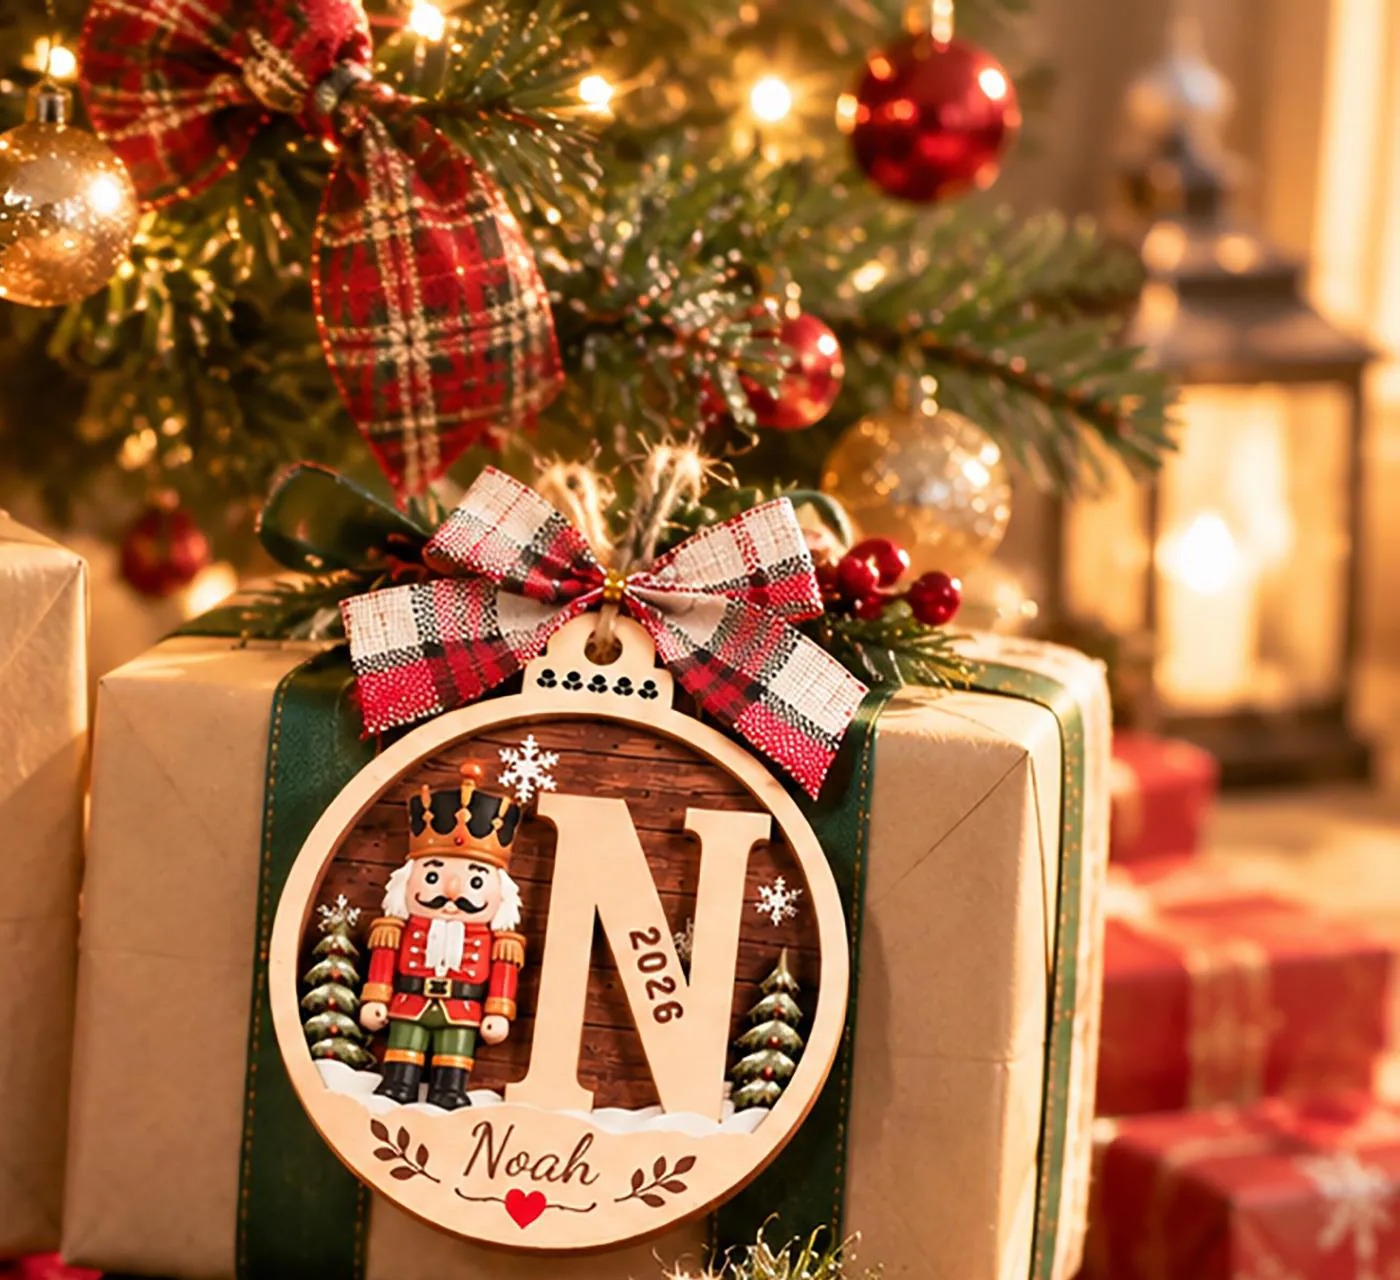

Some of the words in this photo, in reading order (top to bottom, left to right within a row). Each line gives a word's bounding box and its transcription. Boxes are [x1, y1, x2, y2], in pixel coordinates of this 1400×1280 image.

[505, 791, 772, 1124] N
[629, 926, 684, 1026] 2026
[462, 1120, 599, 1186] Noah
